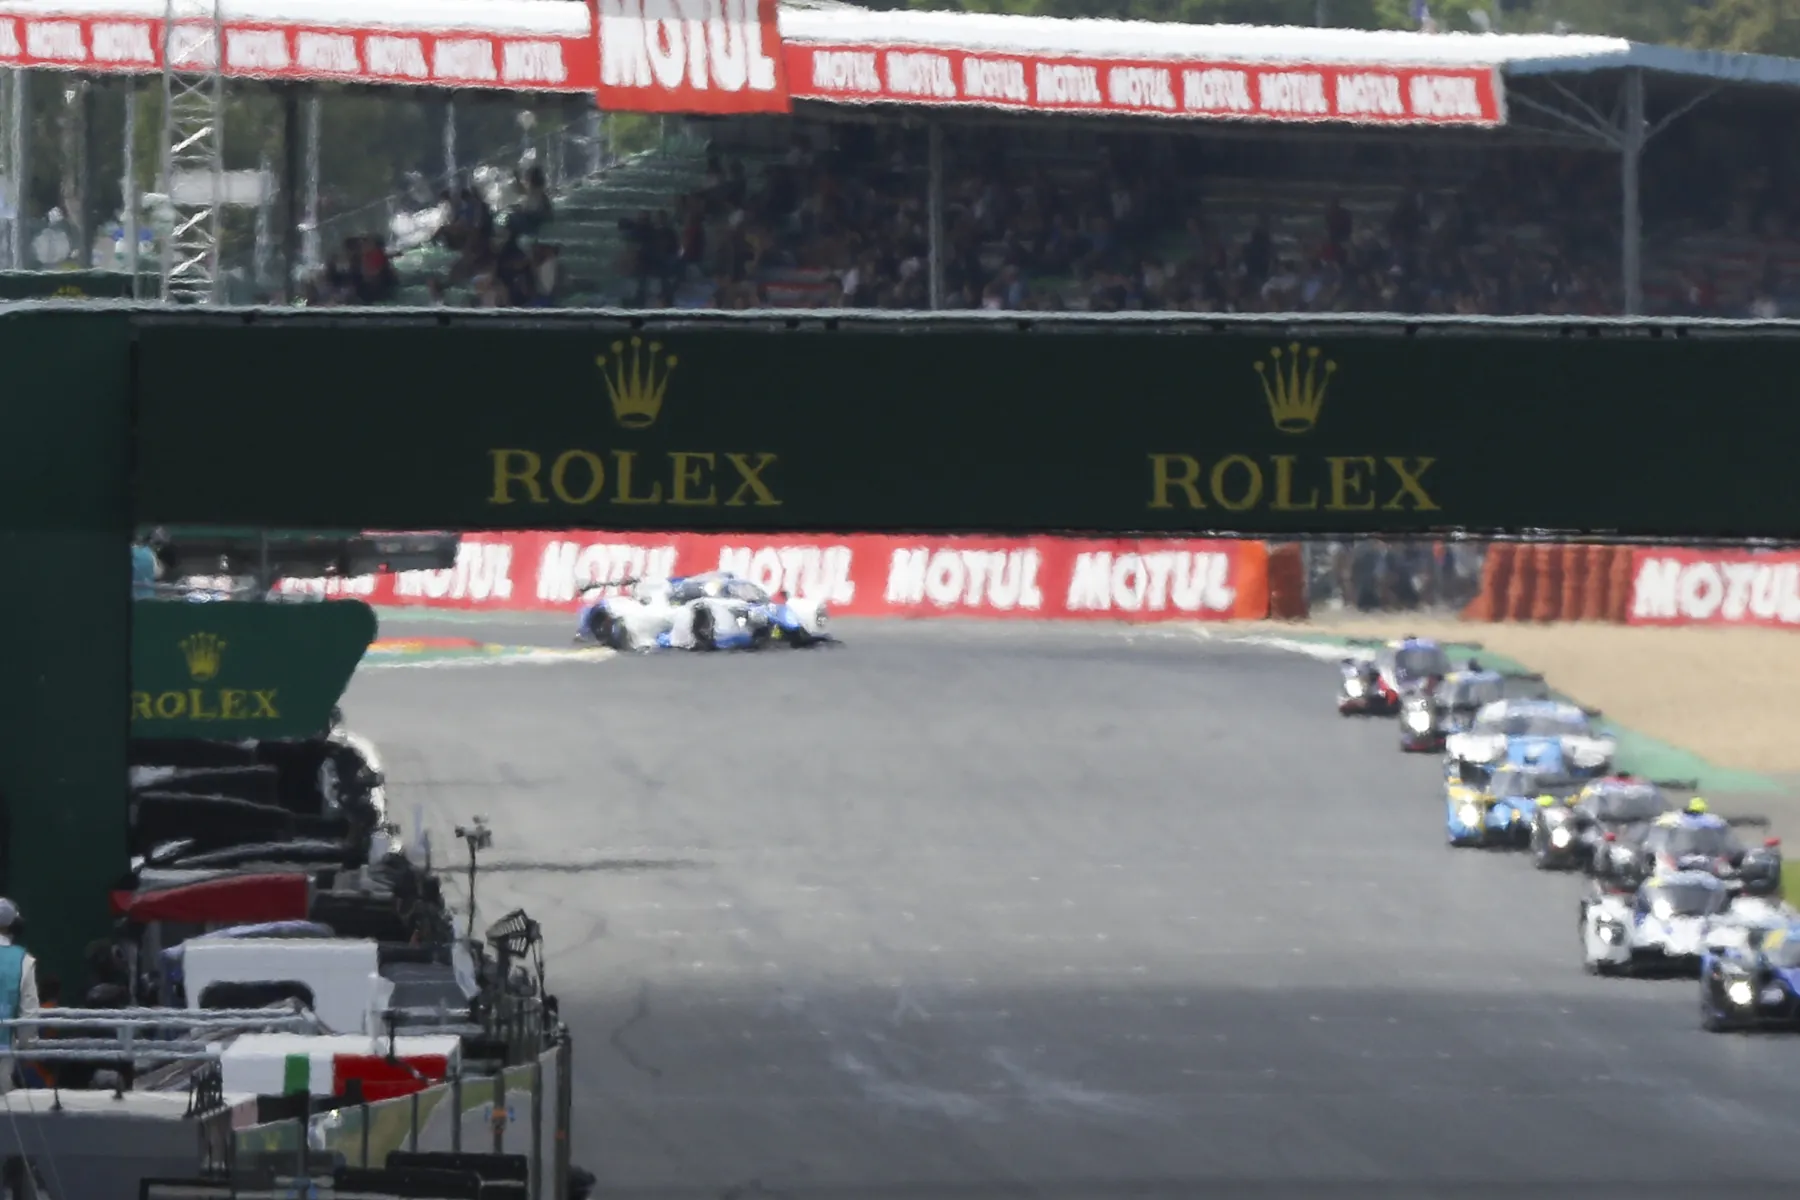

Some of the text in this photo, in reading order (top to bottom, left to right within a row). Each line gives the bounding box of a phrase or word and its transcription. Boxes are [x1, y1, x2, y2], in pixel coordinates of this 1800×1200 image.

[600, 0, 775, 92] MOTUL
[488, 449, 783, 506] ROLEX
[1148, 453, 1441, 511] ROLEX
[885, 547, 1043, 609] MOTUL
[1066, 550, 1236, 613] MOTUL
[132, 690, 280, 720] ROLEX
